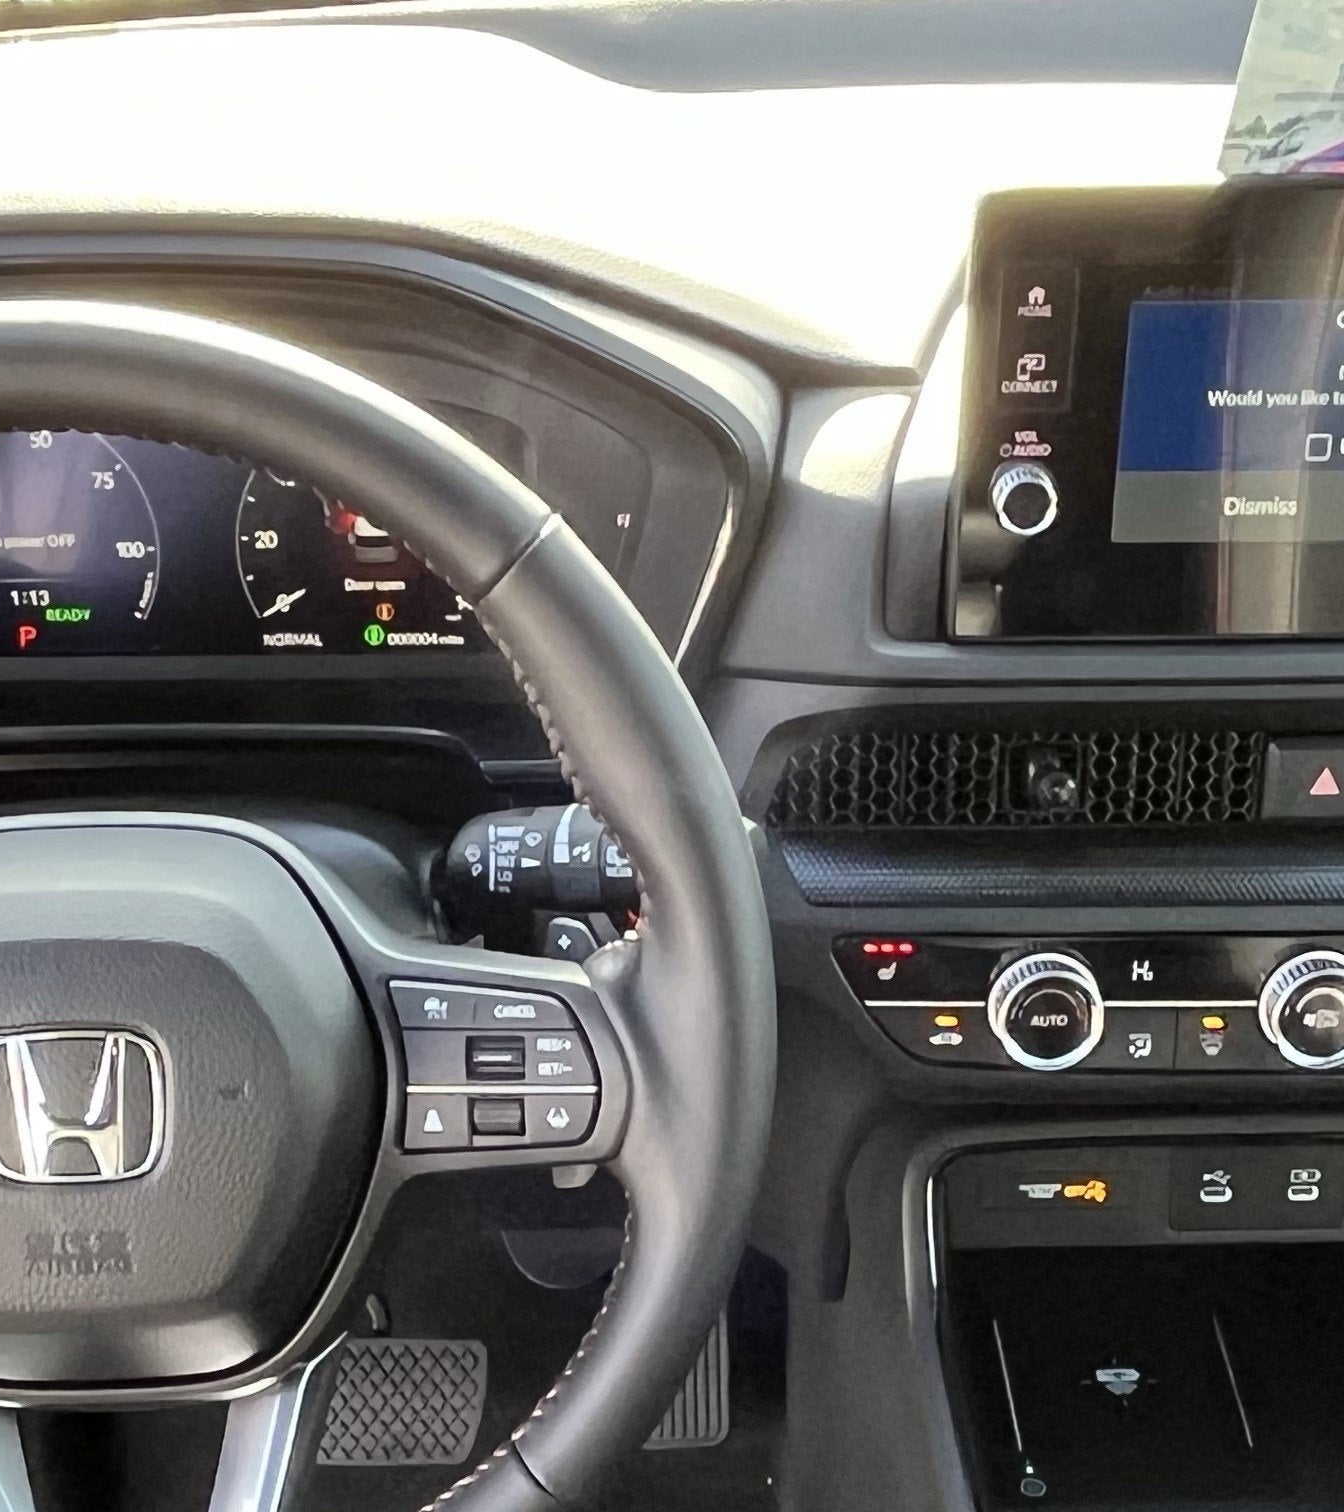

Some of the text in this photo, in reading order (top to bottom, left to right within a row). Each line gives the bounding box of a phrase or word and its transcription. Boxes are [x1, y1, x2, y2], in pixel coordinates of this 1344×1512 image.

[1207, 390, 1262, 407] Would
[1266, 393, 1297, 409] you
[1300, 390, 1329, 406] like
[29, 430, 53, 449] 50
[90, 471, 115, 490] 75
[1223, 496, 1298, 517] Dismiss
[254, 530, 279, 549] 20
[115, 541, 146, 558] 100
[10, 589, 50, 606] 1:13
[45, 608, 92, 622] READY
[19, 626, 37, 649] P
[1029, 1014, 1069, 1027] AUTO
